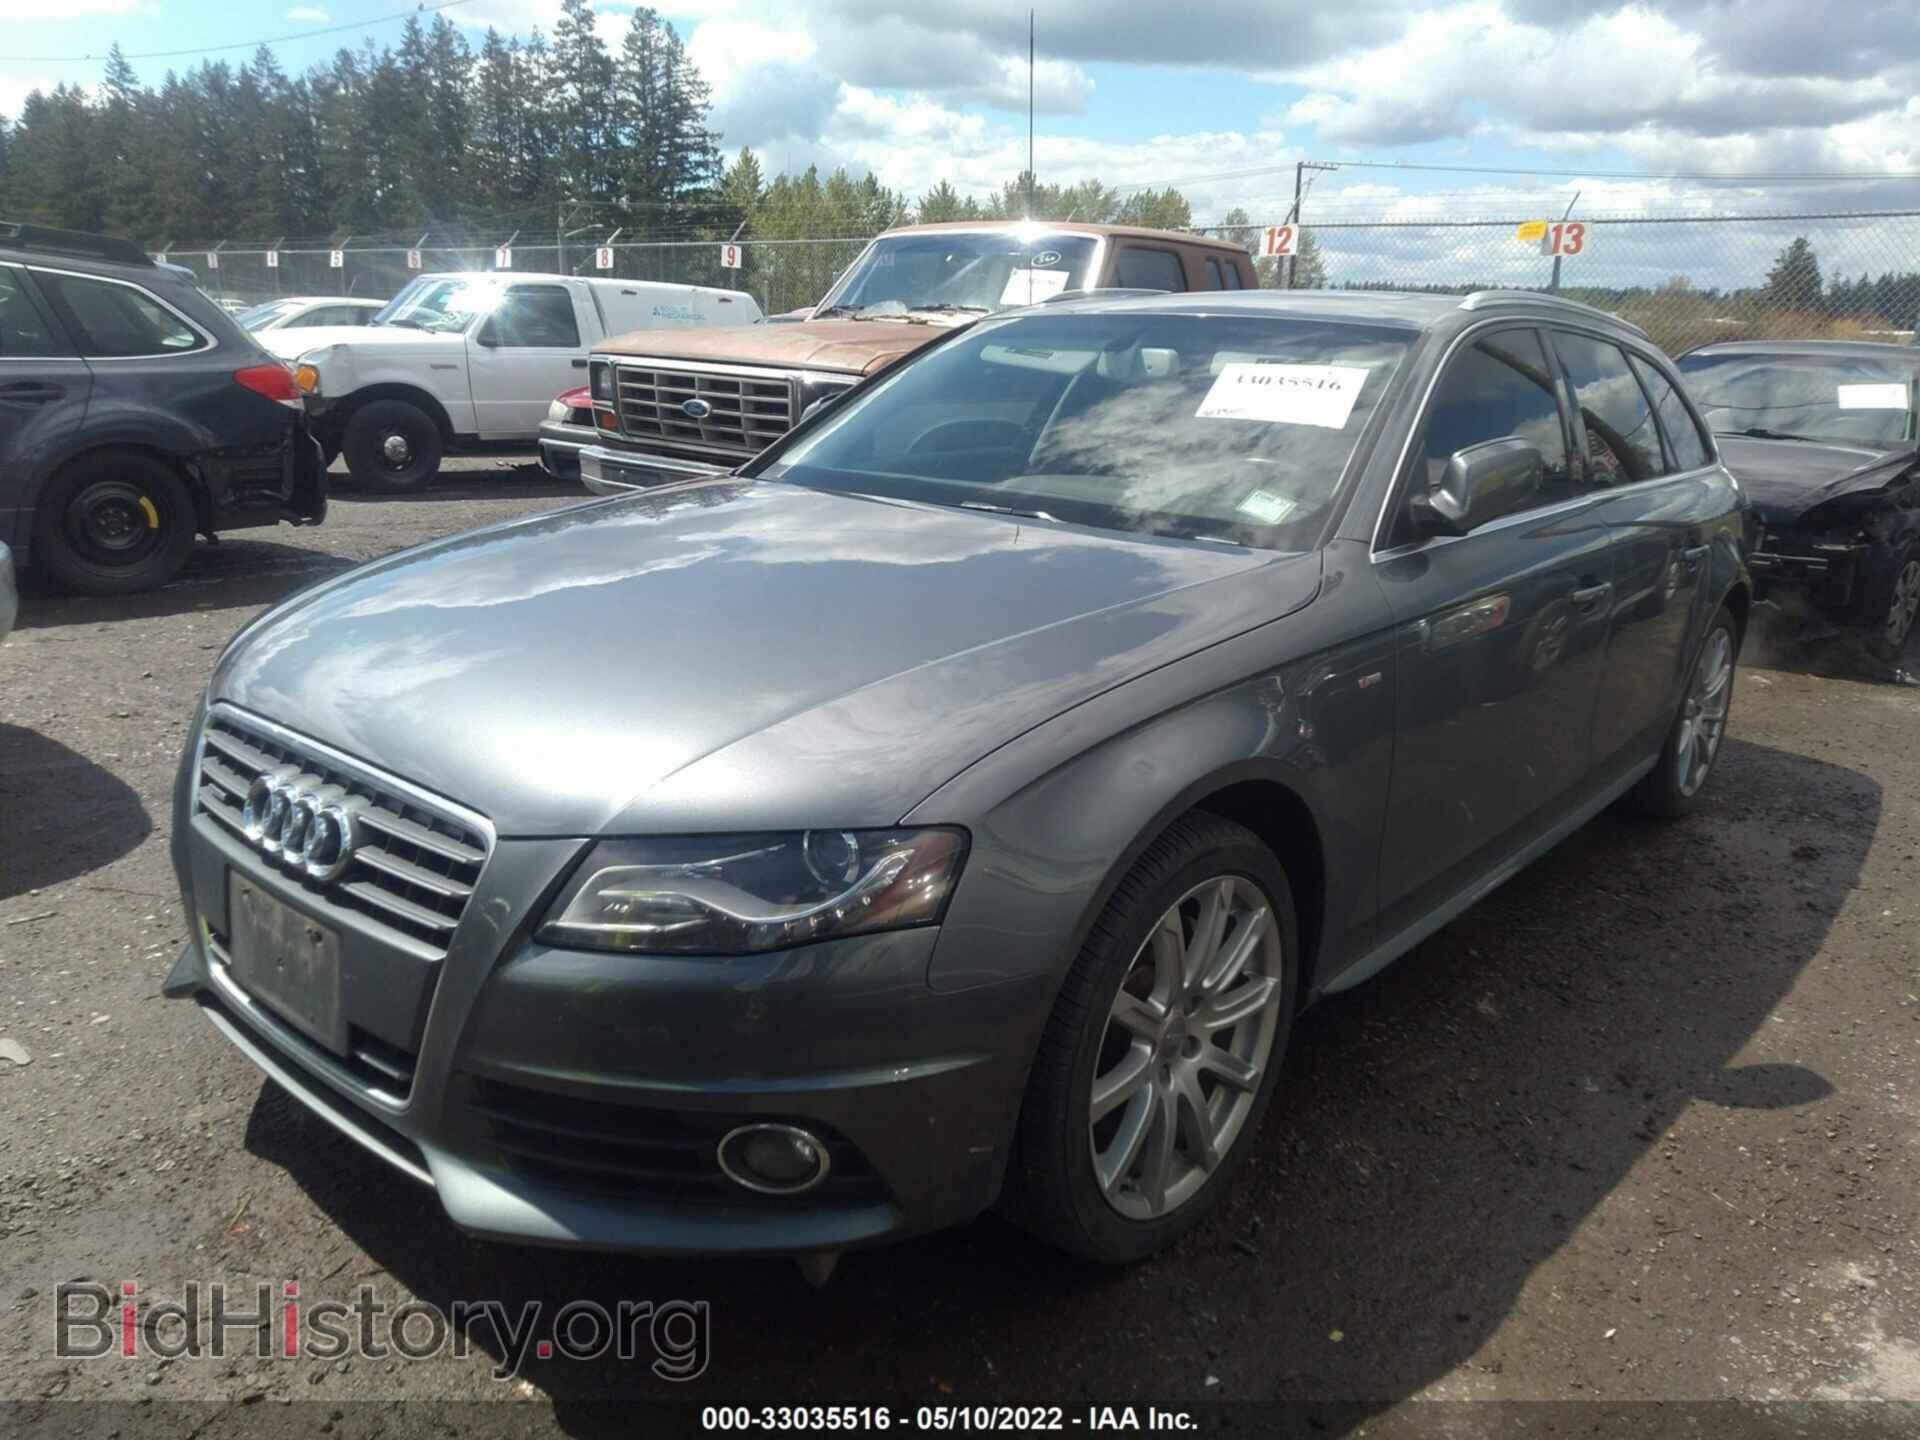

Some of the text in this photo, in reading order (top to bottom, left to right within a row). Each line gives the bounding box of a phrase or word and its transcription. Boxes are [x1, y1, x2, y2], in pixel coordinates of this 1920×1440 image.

[1267, 226, 1293, 255] 12
[1551, 222, 1585, 255] 13
[601, 248, 610, 268] 8
[726, 246, 737, 266] 9
